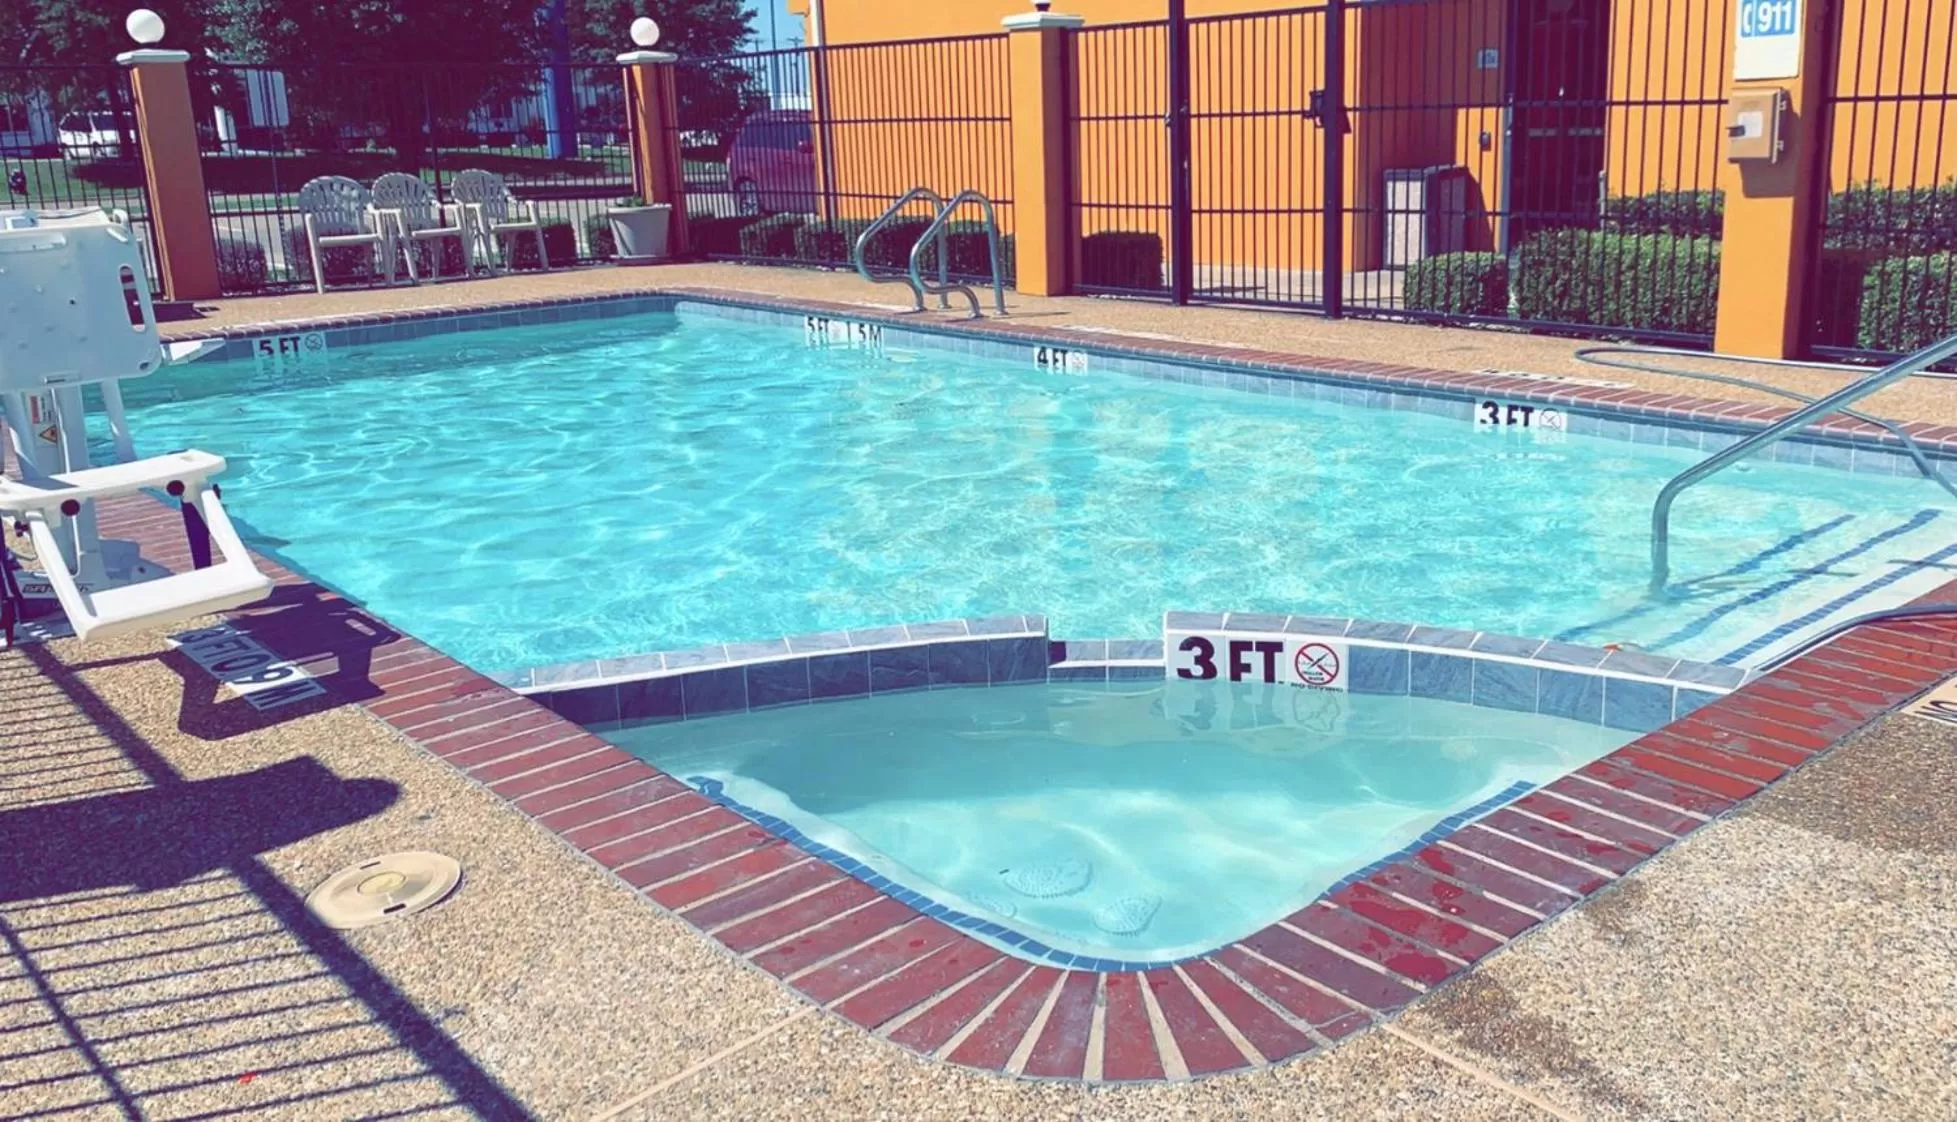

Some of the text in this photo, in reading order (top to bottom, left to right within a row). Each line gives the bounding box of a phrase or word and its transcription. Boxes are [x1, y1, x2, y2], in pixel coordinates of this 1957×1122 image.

[1758, 0, 1792, 32] 911
[259, 335, 300, 355] 5 FT
[1037, 345, 1069, 367] 4 FT
[1479, 401, 1534, 427] 3 FT
[1176, 635, 1284, 683] 3 FT
